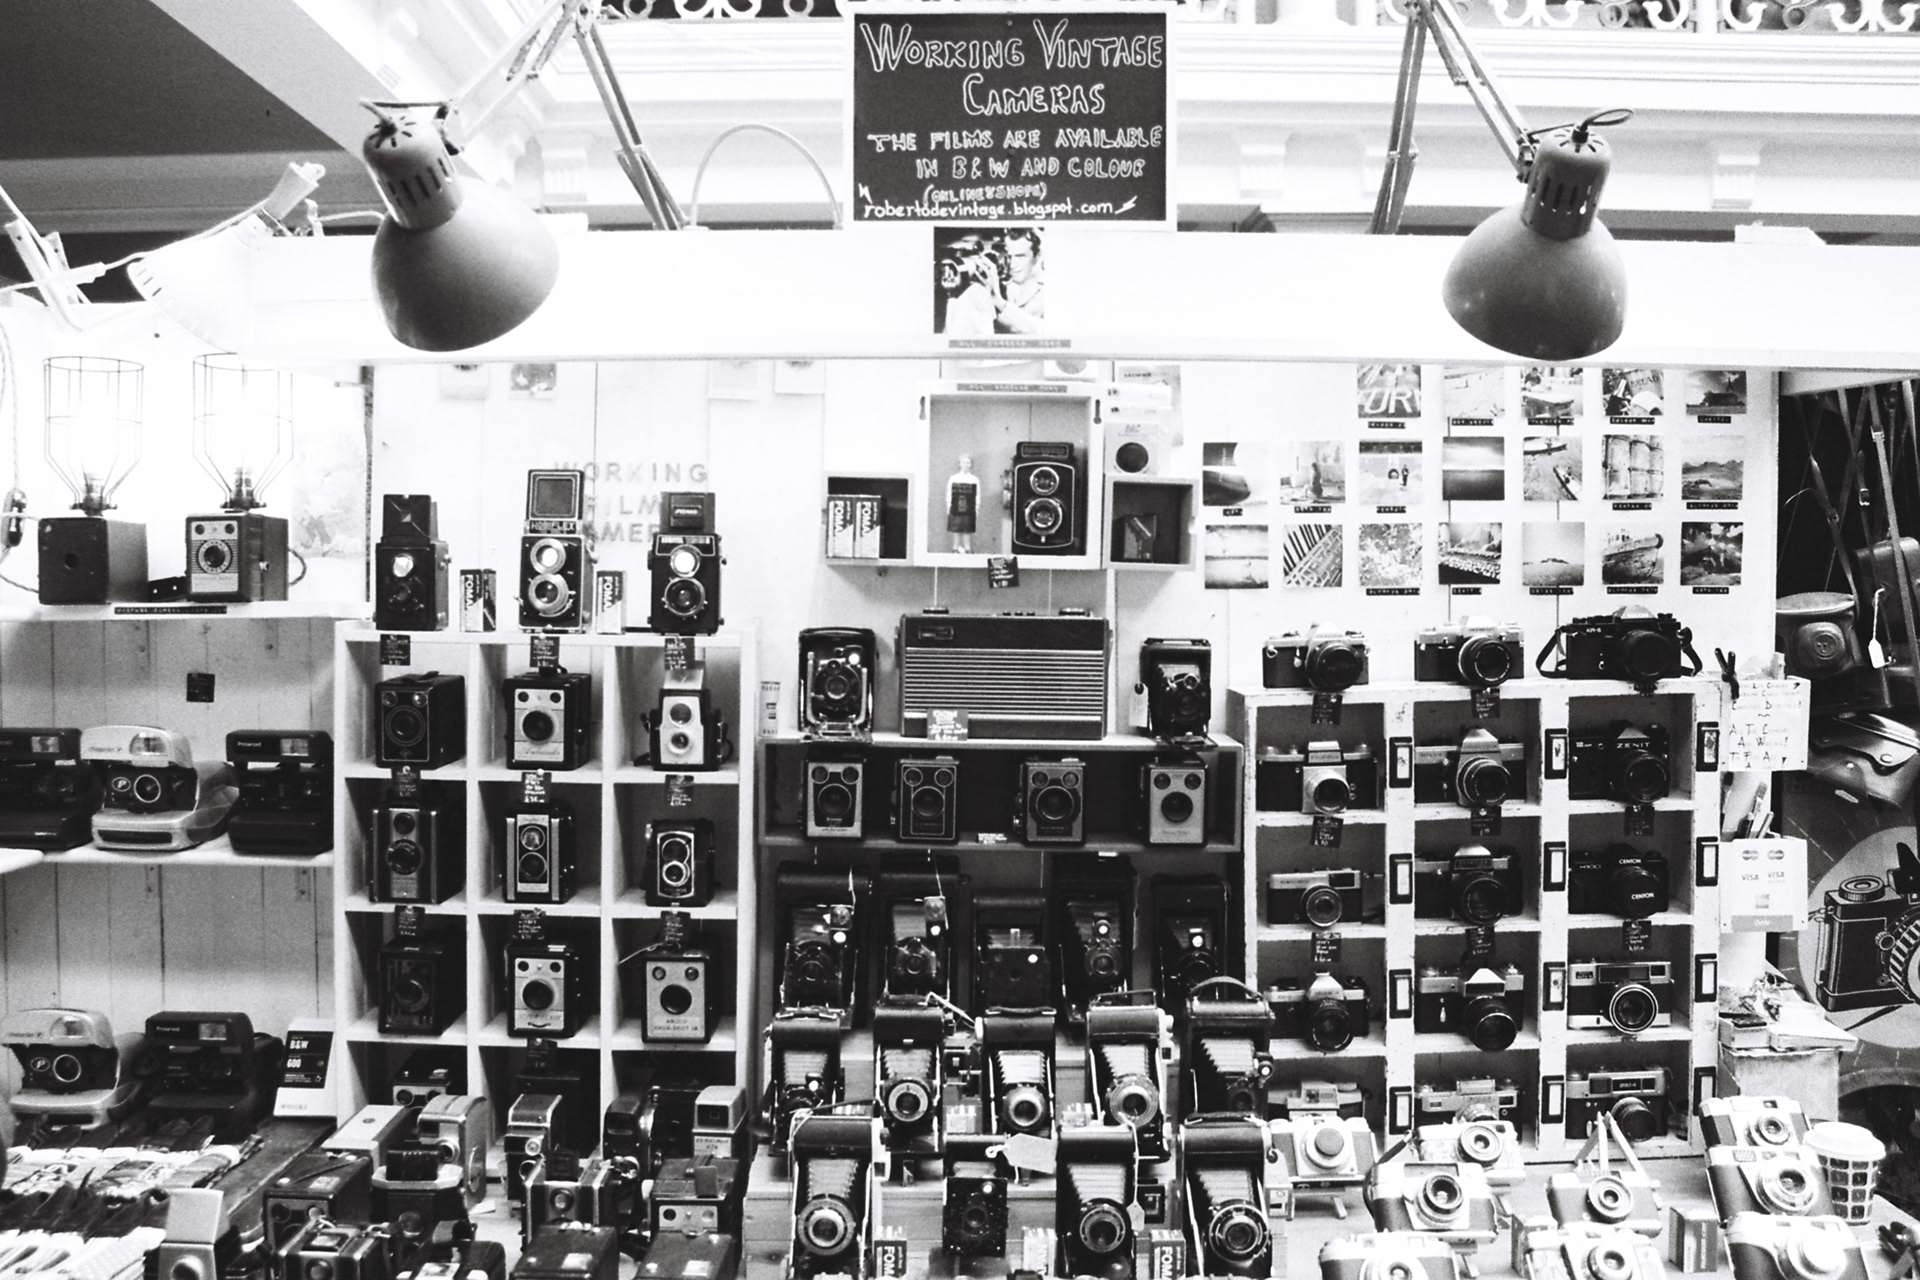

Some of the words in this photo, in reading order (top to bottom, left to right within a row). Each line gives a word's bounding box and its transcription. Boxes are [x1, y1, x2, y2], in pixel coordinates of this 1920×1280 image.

[860, 23, 1025, 72] WORKING
[1033, 18, 1164, 70] VINTAGE
[963, 72, 1106, 116] CAMERAS
[867, 132, 917, 152] THE
[930, 128, 993, 151] FILMS
[1003, 129, 1041, 150] ARE
[1055, 125, 1163, 150] AVAILABLE
[916, 158, 938, 179] IN
[1021, 157, 1060, 177] AND
[1067, 157, 1146, 179] COLOUR
[1616, 741, 1651, 749] ZENIT
[1741, 873, 1759, 881] VISA
[1631, 892, 1655, 900] CENTON
[289, 1040, 309, 1050] B&W
